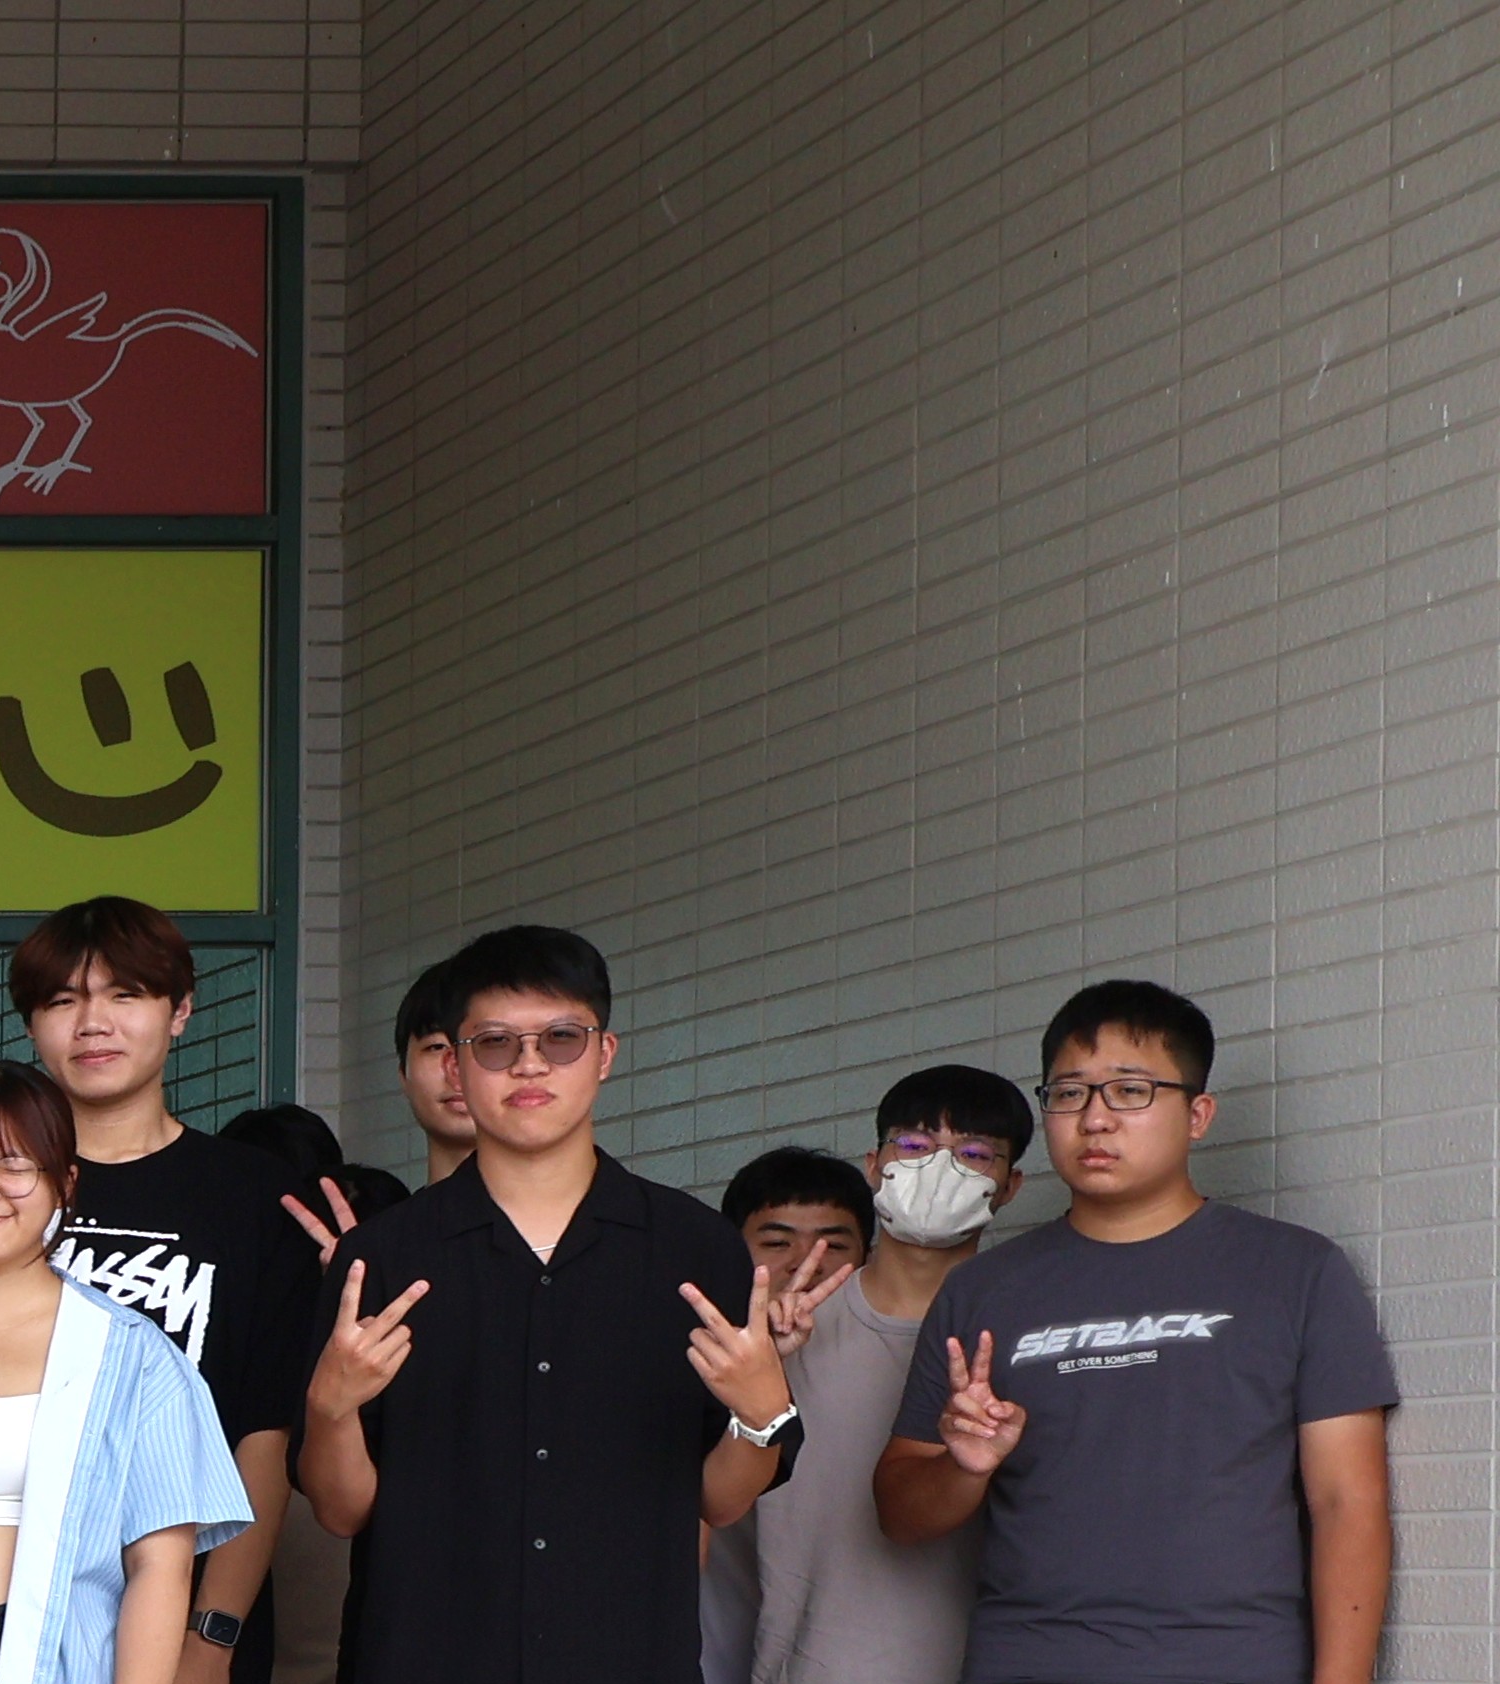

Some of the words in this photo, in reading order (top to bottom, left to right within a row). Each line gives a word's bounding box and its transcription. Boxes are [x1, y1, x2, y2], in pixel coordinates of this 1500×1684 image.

[1011, 1313, 1234, 1367] SETBACK
[1056, 1358, 1076, 1371] GET
[1077, 1355, 1103, 1369] OVER
